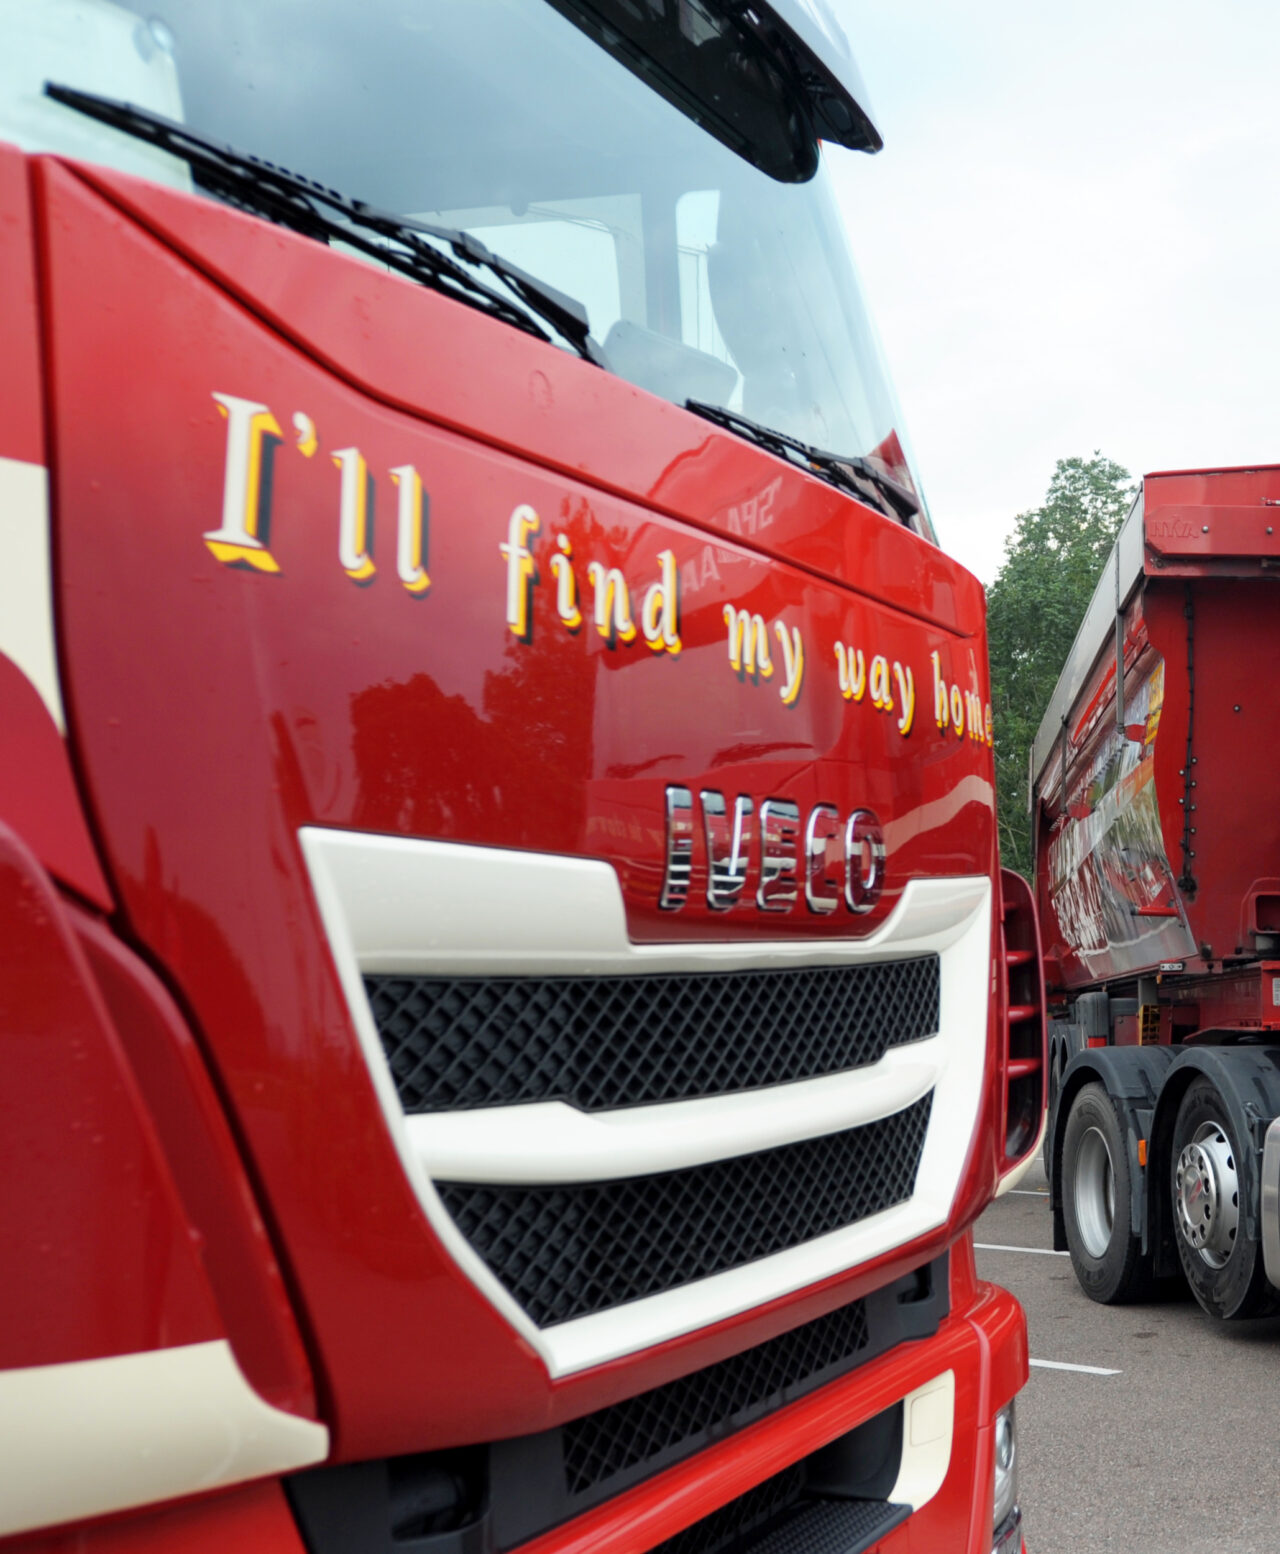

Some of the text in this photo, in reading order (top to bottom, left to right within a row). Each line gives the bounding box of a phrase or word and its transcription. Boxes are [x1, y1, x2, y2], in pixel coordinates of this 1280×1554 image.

[202, 390, 431, 600] I'll
[500, 504, 682, 661] find
[723, 604, 804, 708] my
[834, 641, 916, 737] way
[930, 651, 993, 748] home
[658, 783, 887, 915] IVECO
